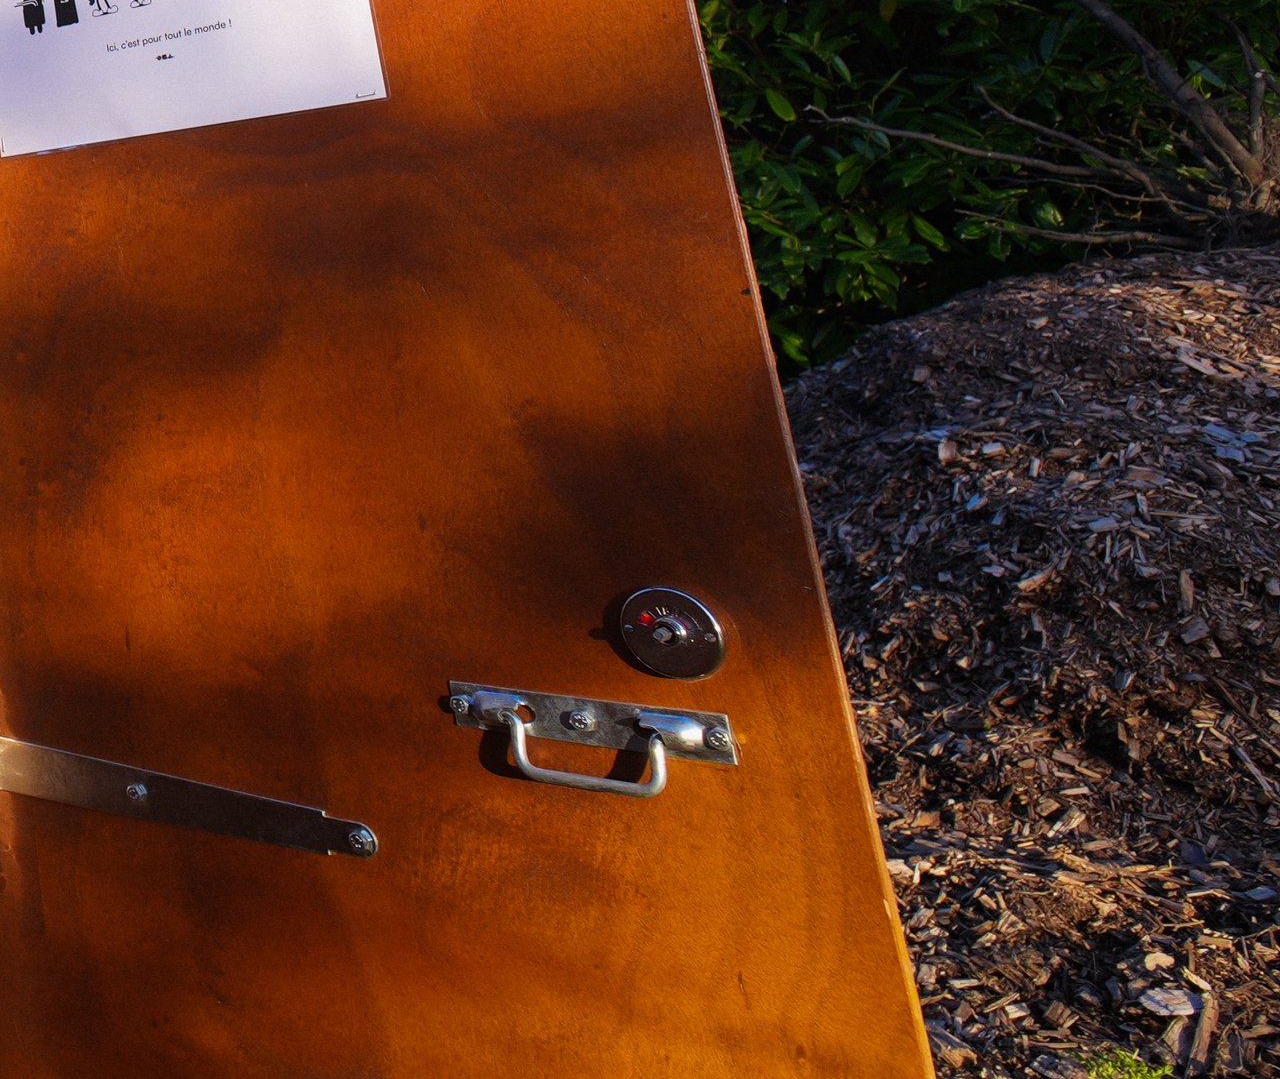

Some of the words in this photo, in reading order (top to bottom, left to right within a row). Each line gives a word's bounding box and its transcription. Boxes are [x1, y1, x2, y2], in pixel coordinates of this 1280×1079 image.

[106, 43, 120, 53] Ici,
[121, 39, 140, 50] c'est
[142, 35, 162, 47] pour
[164, 30, 182, 41] tout
[183, 28, 192, 37] le
[194, 21, 226, 35] monde
